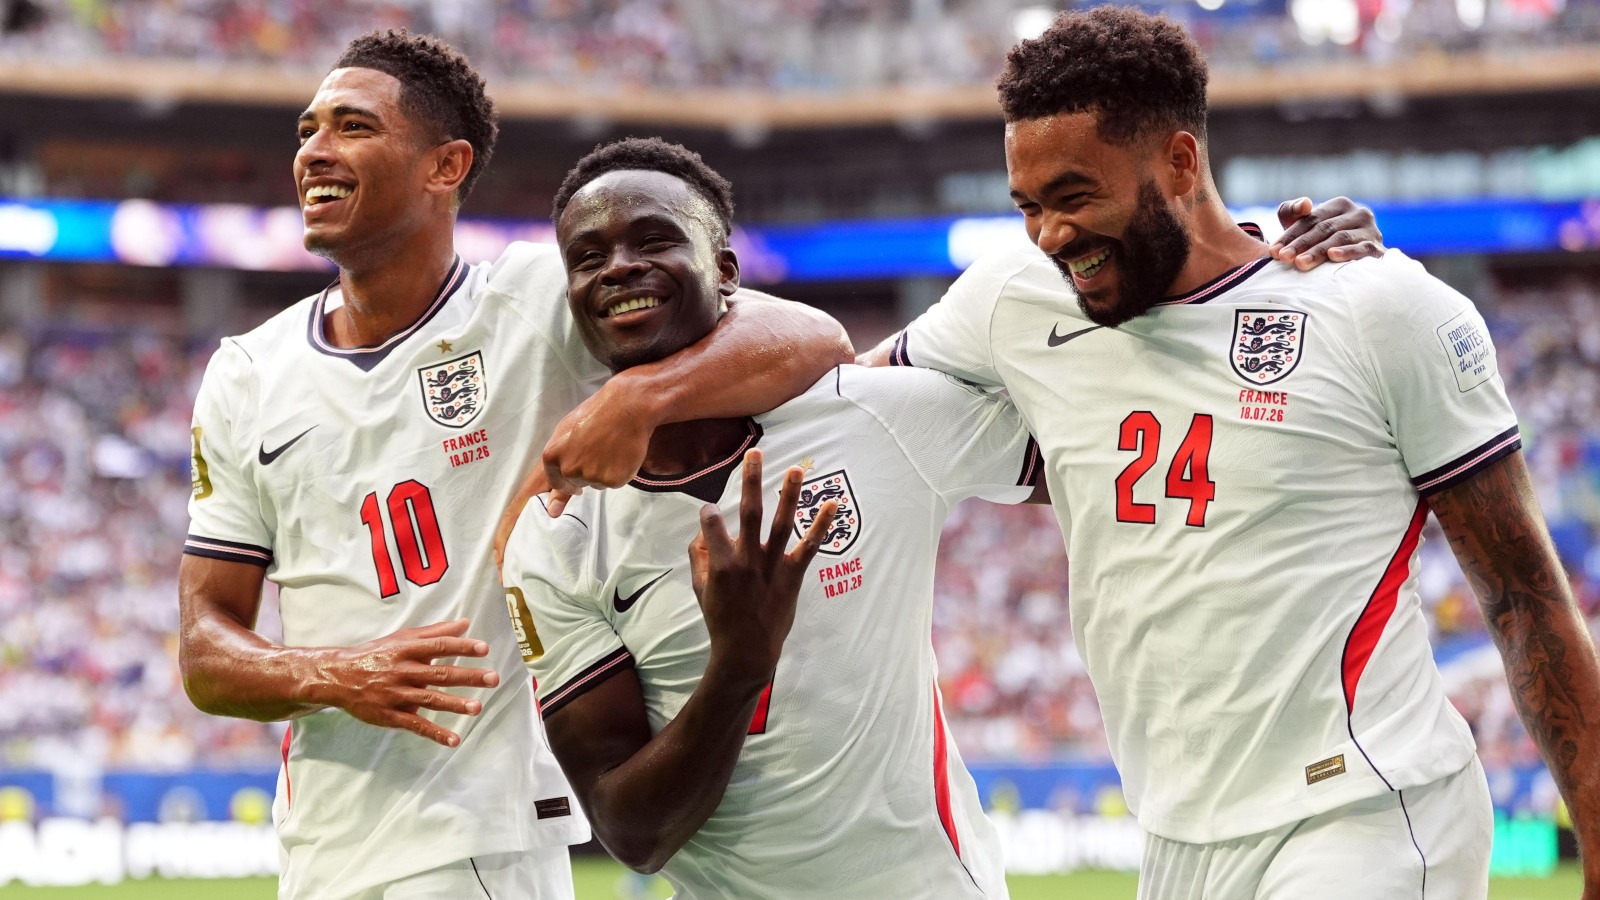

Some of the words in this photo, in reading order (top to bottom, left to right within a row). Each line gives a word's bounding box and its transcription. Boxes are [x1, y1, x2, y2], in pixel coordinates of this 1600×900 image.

[1453, 329, 1484, 357] UNITES
[1458, 359, 1474, 372] the
[1474, 365, 1486, 375] FIFA
[1239, 389, 1287, 405] FRANCE
[1240, 406, 1284, 422] 18.07.26
[443, 429, 488, 452] FRANCE
[449, 445, 490, 467] 18.07.26
[1115, 410, 1215, 527] 24
[360, 479, 449, 599] 10
[819, 557, 862, 582] FRANCE
[824, 574, 862, 598] 18.07.26
